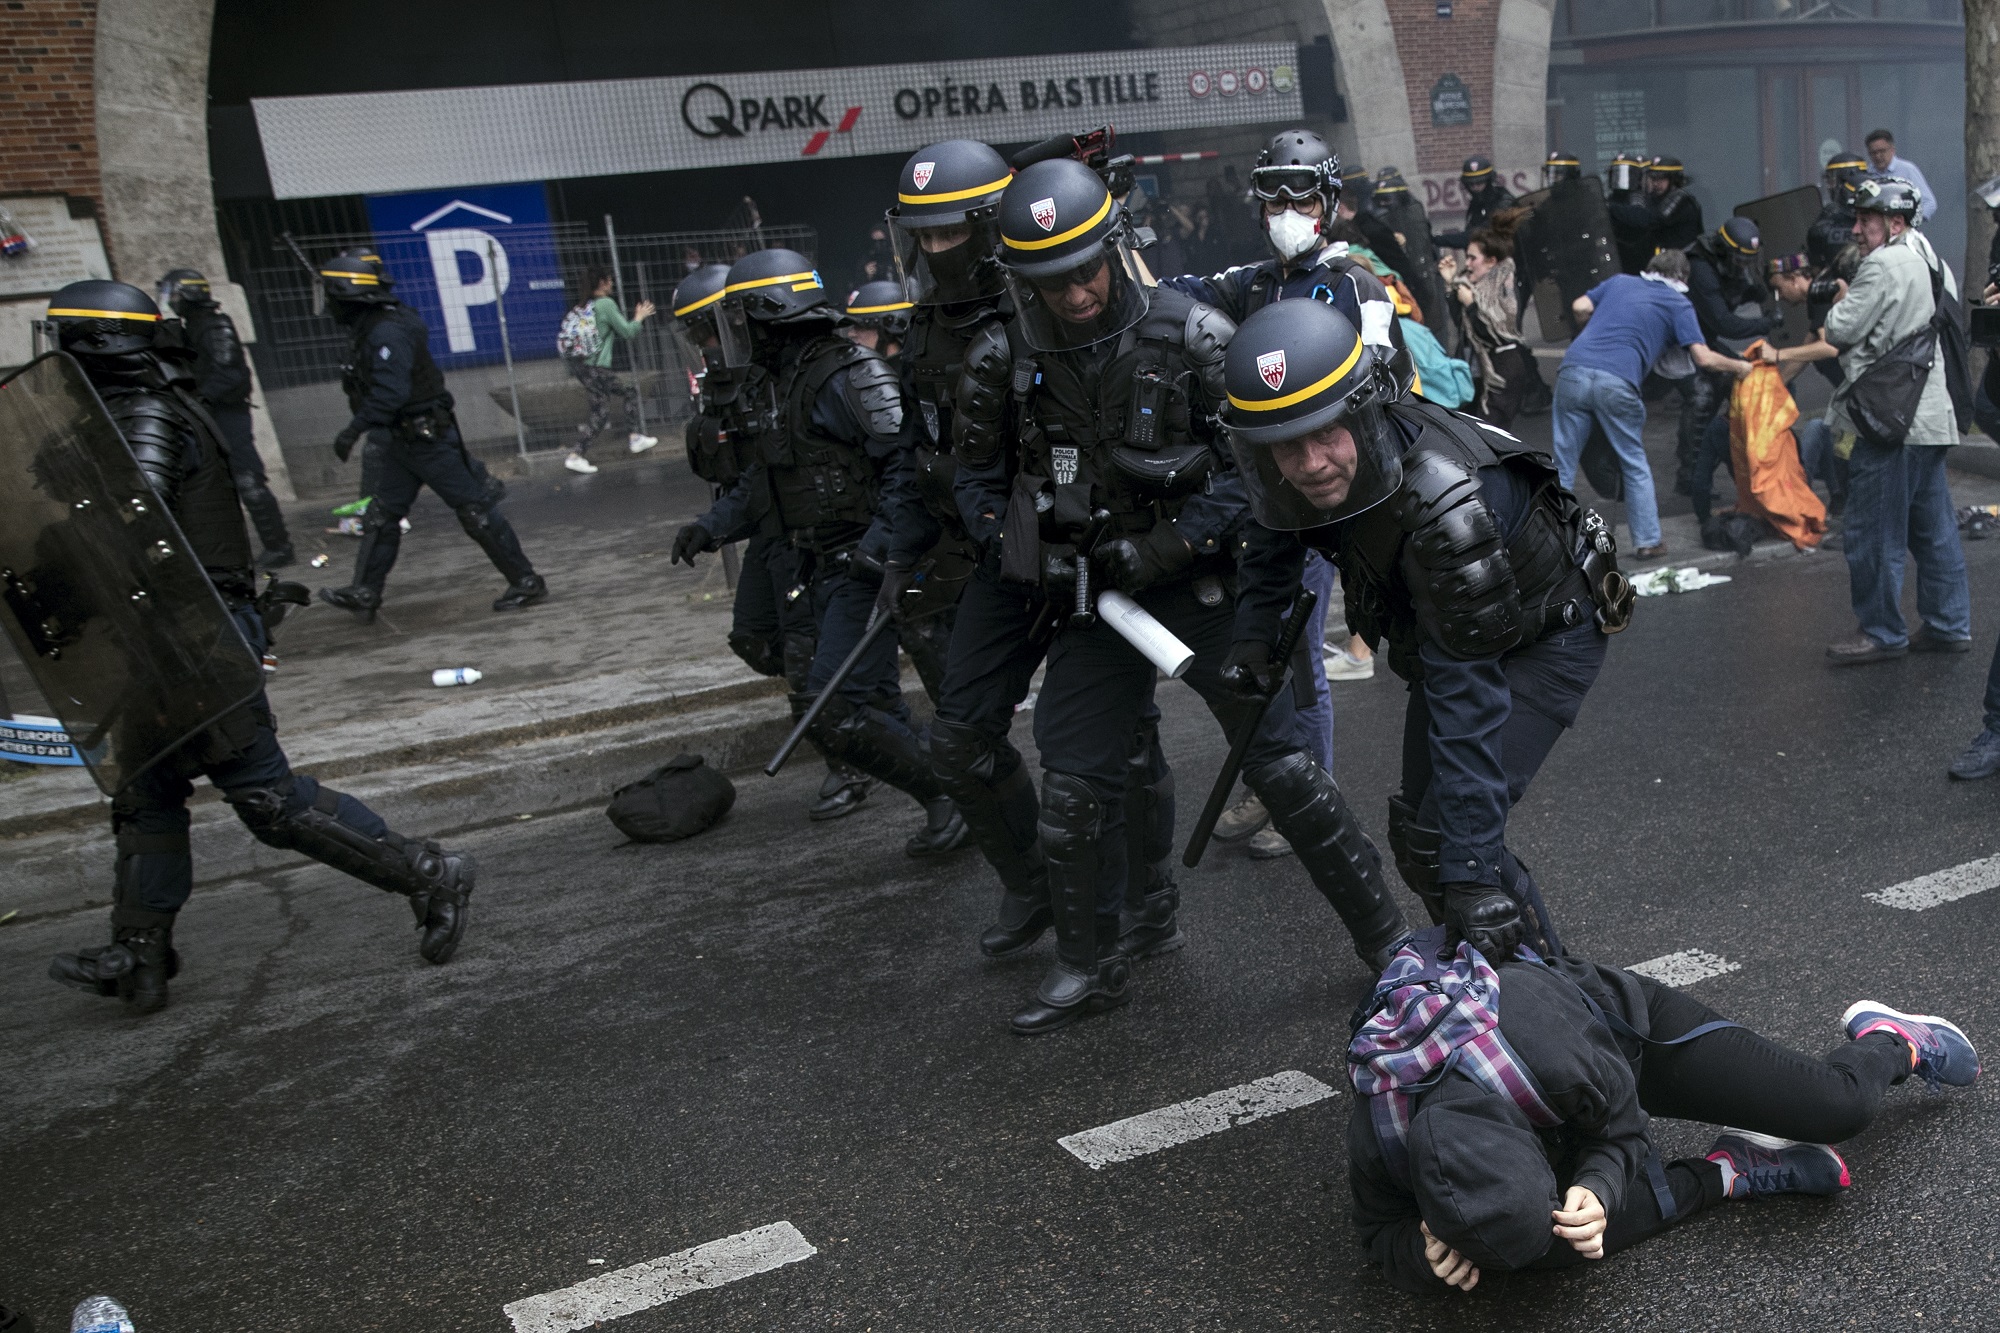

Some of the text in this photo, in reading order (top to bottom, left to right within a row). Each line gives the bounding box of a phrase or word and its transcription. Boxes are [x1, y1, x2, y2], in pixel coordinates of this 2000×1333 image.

[894, 72, 1160, 120] OPÉRA BASTILLE
[1315, 153, 1340, 176] PRES
[915, 170, 930, 178] CRS
[1036, 208, 1053, 219] CRS
[425, 228, 510, 353] P
[1262, 363, 1283, 376] CRS
[1053, 459, 1077, 472] CRS
[36, 745, 70, 756] D'ART
